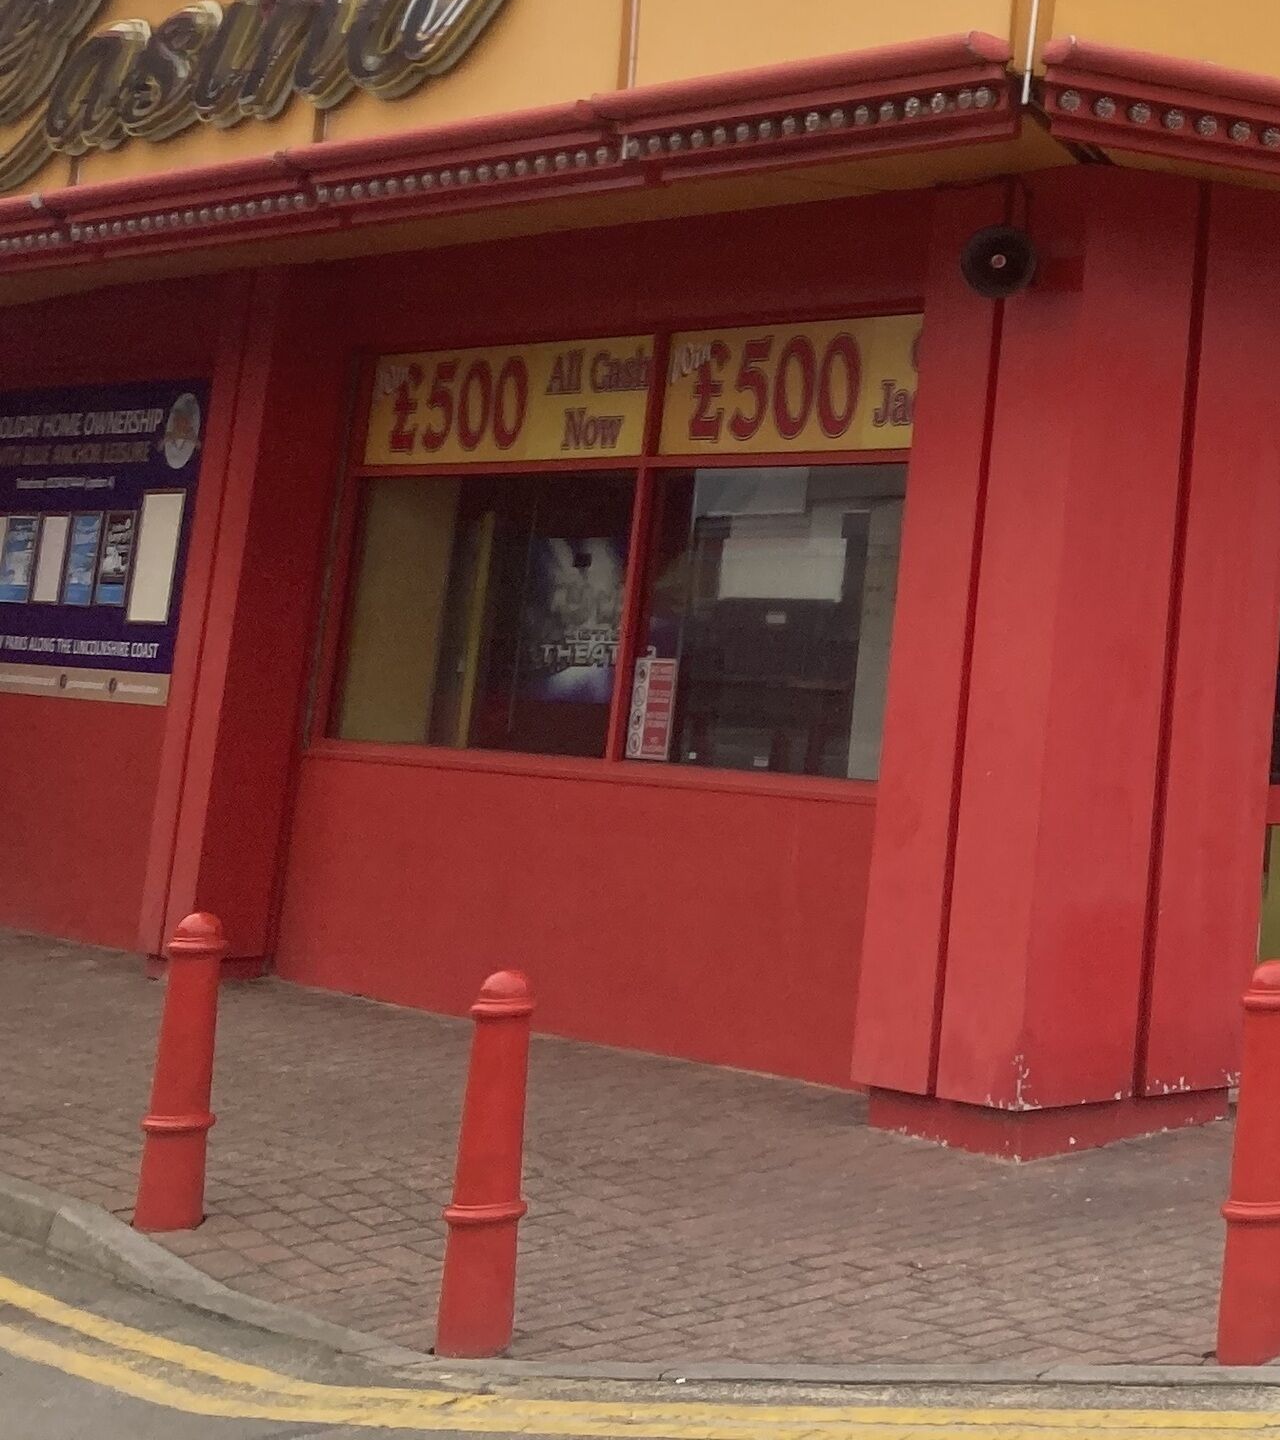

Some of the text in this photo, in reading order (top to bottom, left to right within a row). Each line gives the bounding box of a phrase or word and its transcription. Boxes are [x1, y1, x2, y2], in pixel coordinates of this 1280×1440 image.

[388, 356, 530, 455] £500
[688, 332, 863, 443] £500
[873, 379, 916, 428] Ja
[84, 408, 164, 436] OWNERSHIP
[561, 407, 625, 451] Now
[57, 638, 73, 654] THE
[73, 639, 130, 657] LINCOLNSHIRE
[131, 642, 160, 658] COAST
